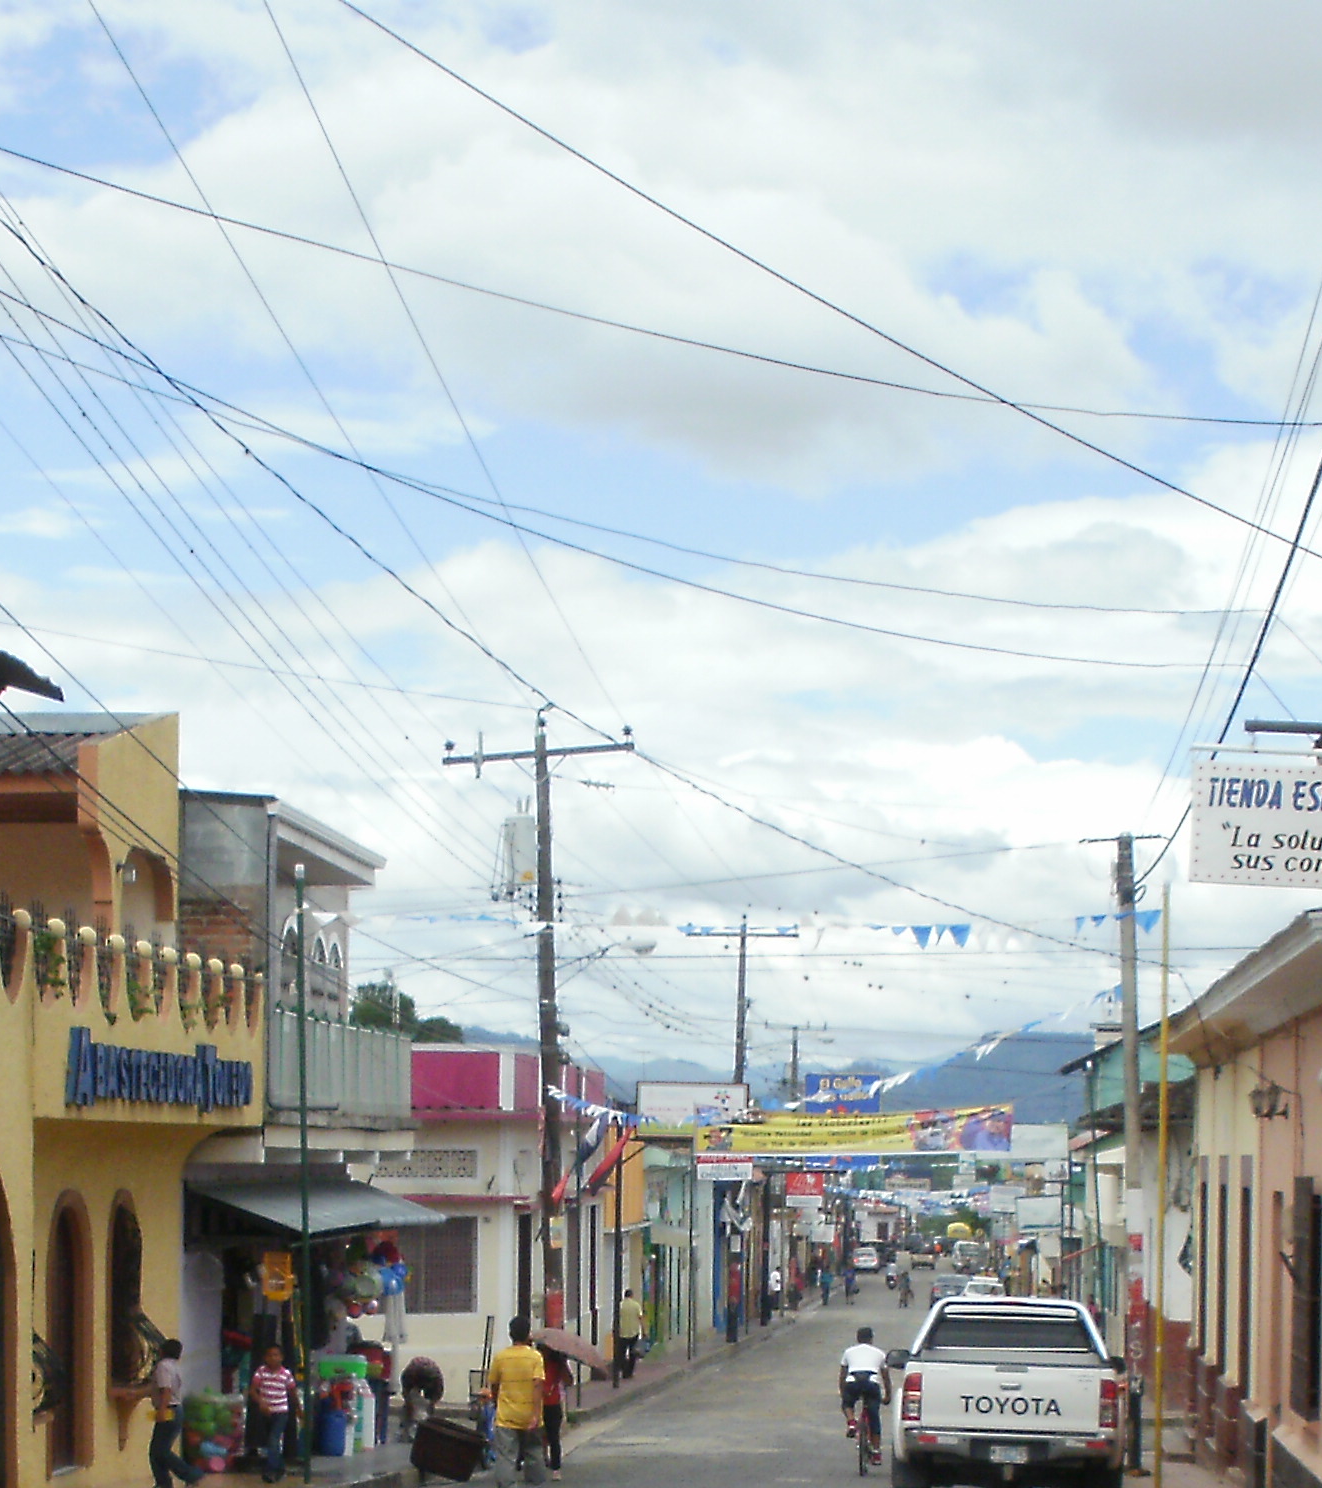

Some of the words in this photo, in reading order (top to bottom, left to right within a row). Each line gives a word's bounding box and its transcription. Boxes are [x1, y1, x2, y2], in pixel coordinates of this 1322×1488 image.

[1208, 776, 1283, 811] TIENDA
[1230, 853, 1274, 872] sus
[960, 1395, 1062, 1417] TOYOTA
